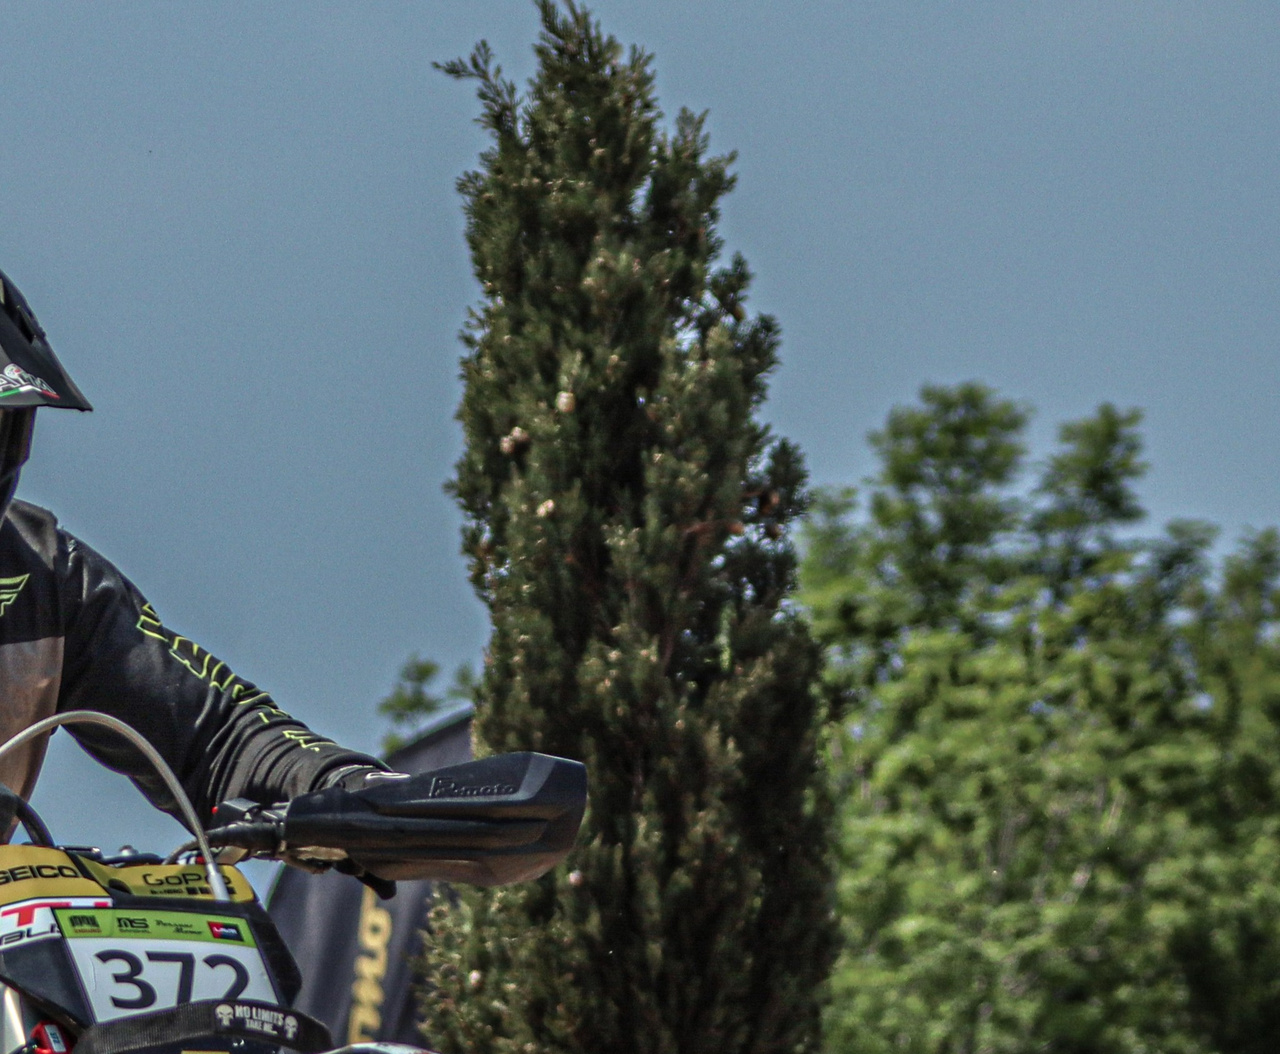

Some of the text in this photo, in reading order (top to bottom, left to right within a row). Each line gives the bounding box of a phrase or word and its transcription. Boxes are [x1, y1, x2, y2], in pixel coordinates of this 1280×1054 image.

[142, 873, 232, 887] GoPo
[95, 949, 249, 1010] 372
[235, 1004, 285, 1026] NO LIMITS
